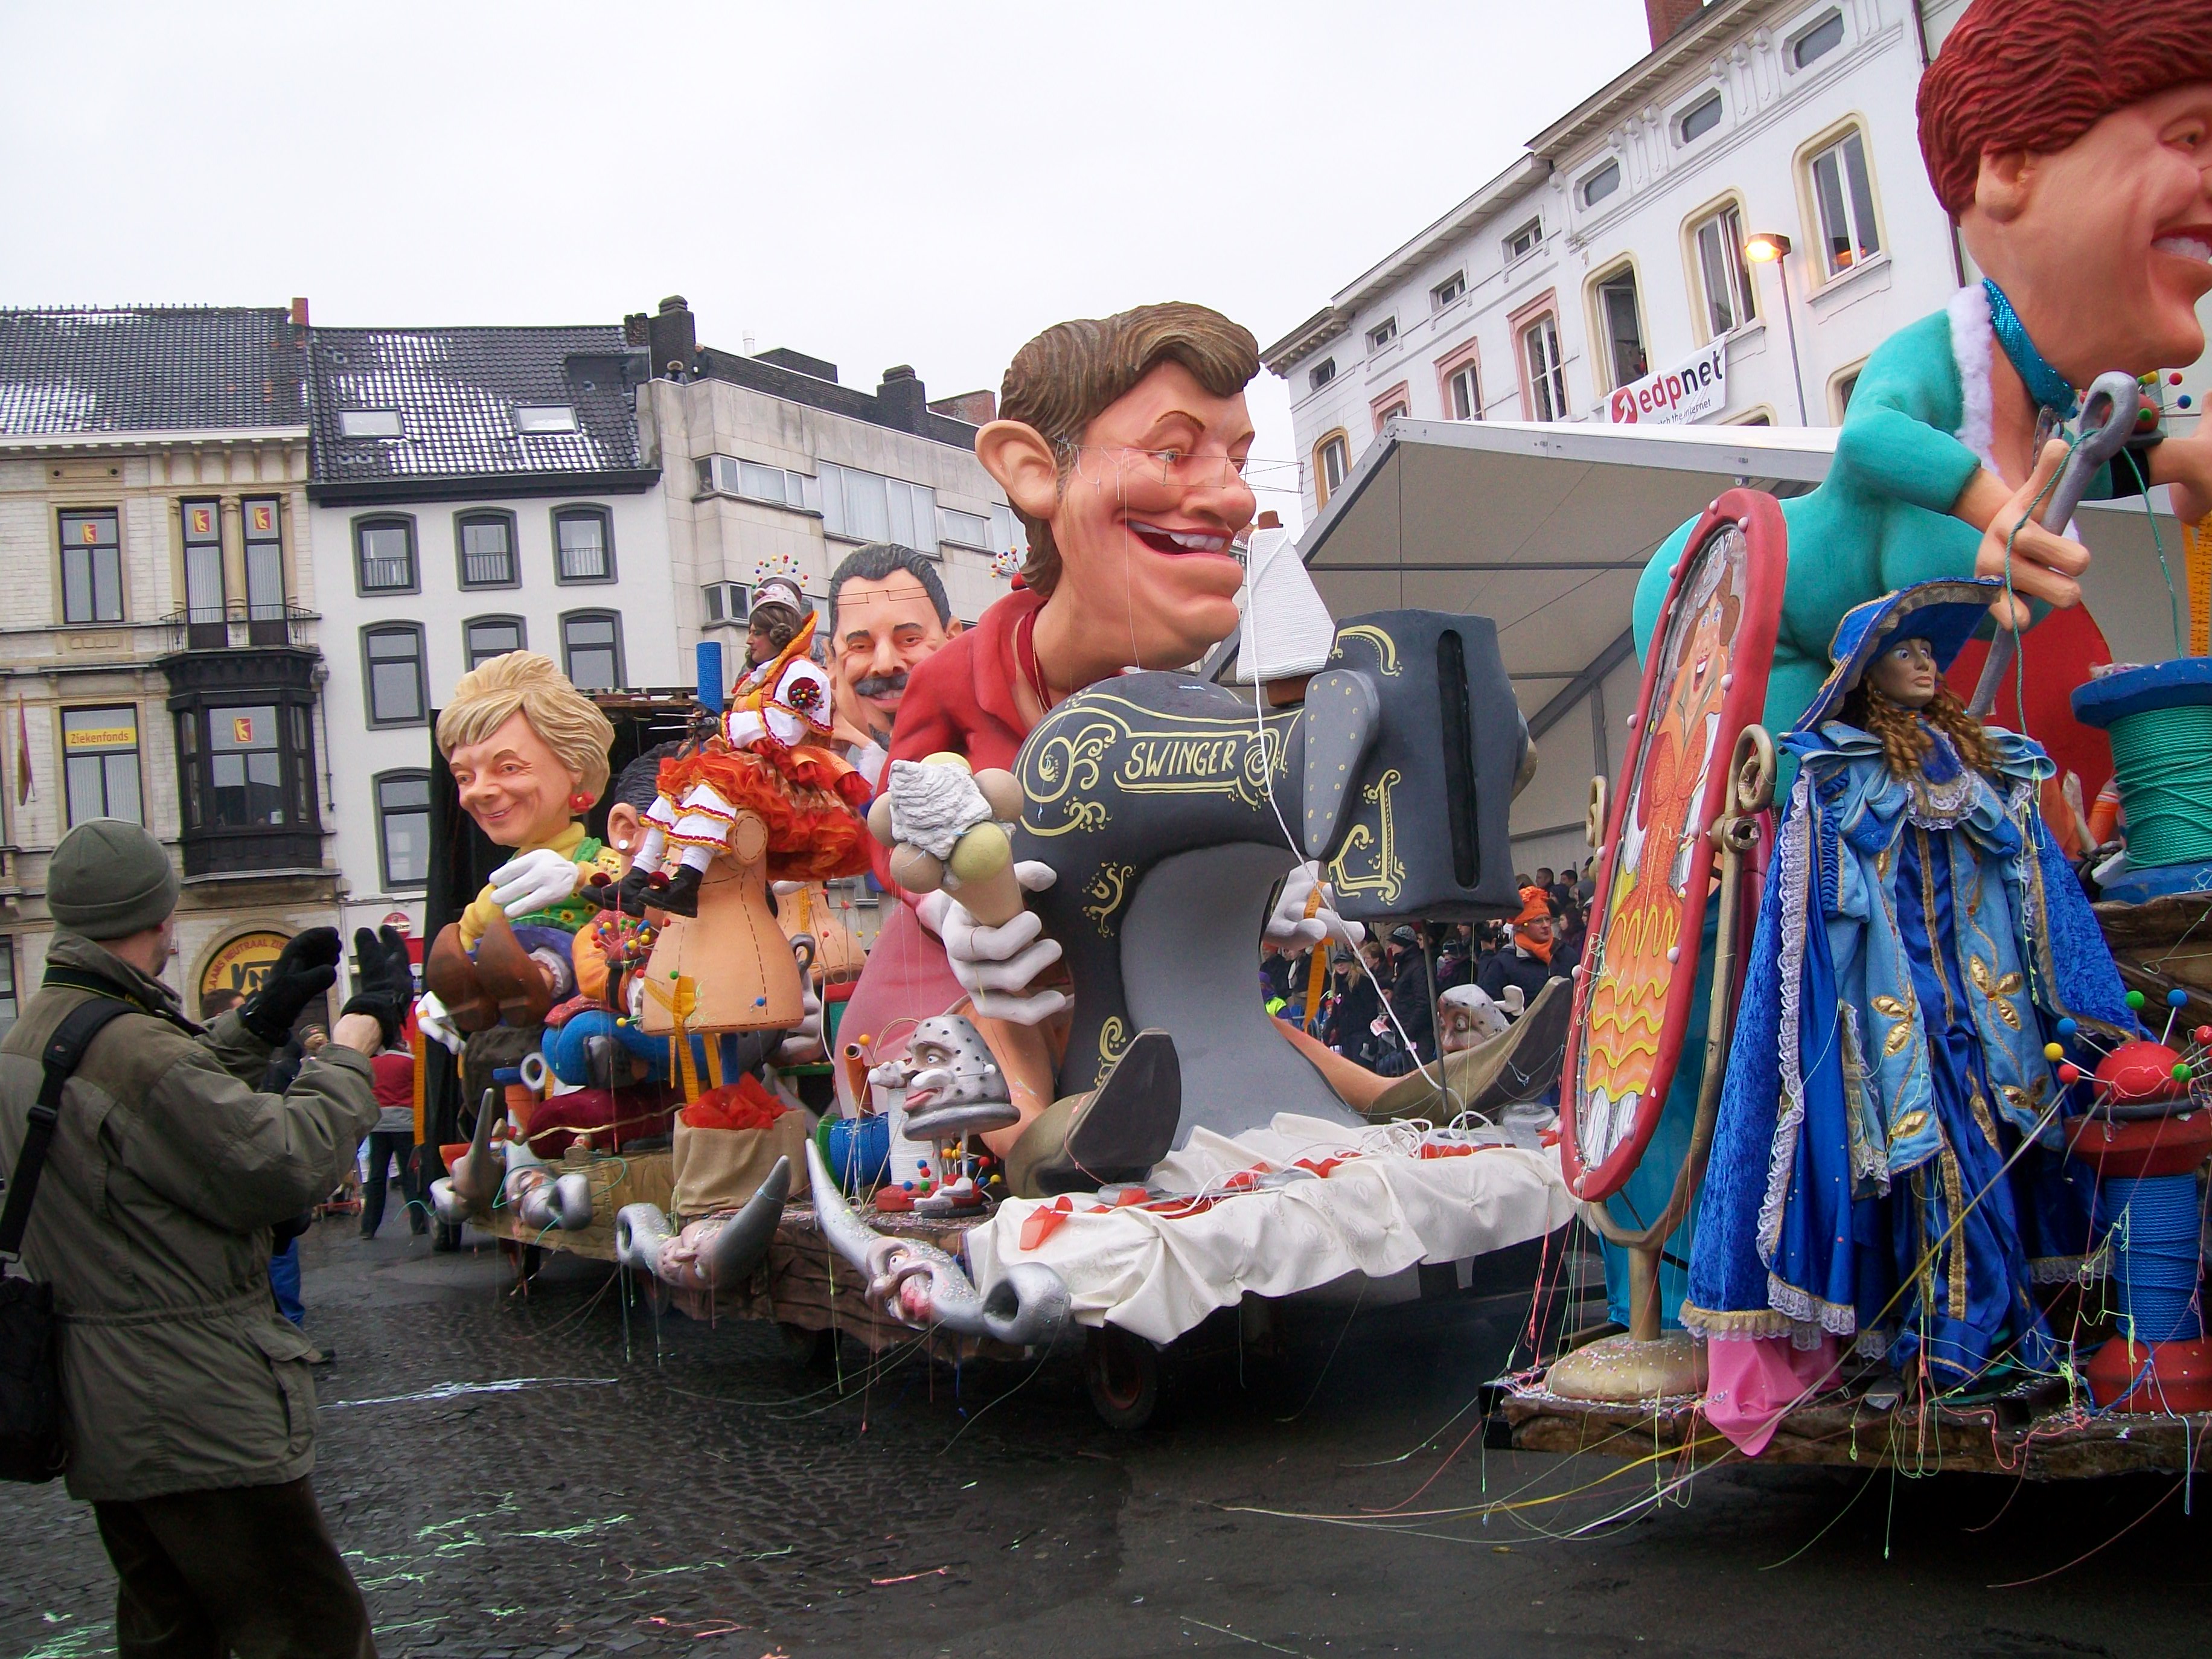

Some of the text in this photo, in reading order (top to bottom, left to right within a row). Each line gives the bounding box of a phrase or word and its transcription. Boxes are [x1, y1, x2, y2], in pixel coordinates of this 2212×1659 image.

[1639, 350, 1722, 413] edpnet
[1672, 413, 1683, 422] the
[70, 730, 129, 744] Ziekenfonds
[1124, 740, 1237, 780] SWINGER
[207, 939, 267, 991] LAAMS NEUTRAAL
